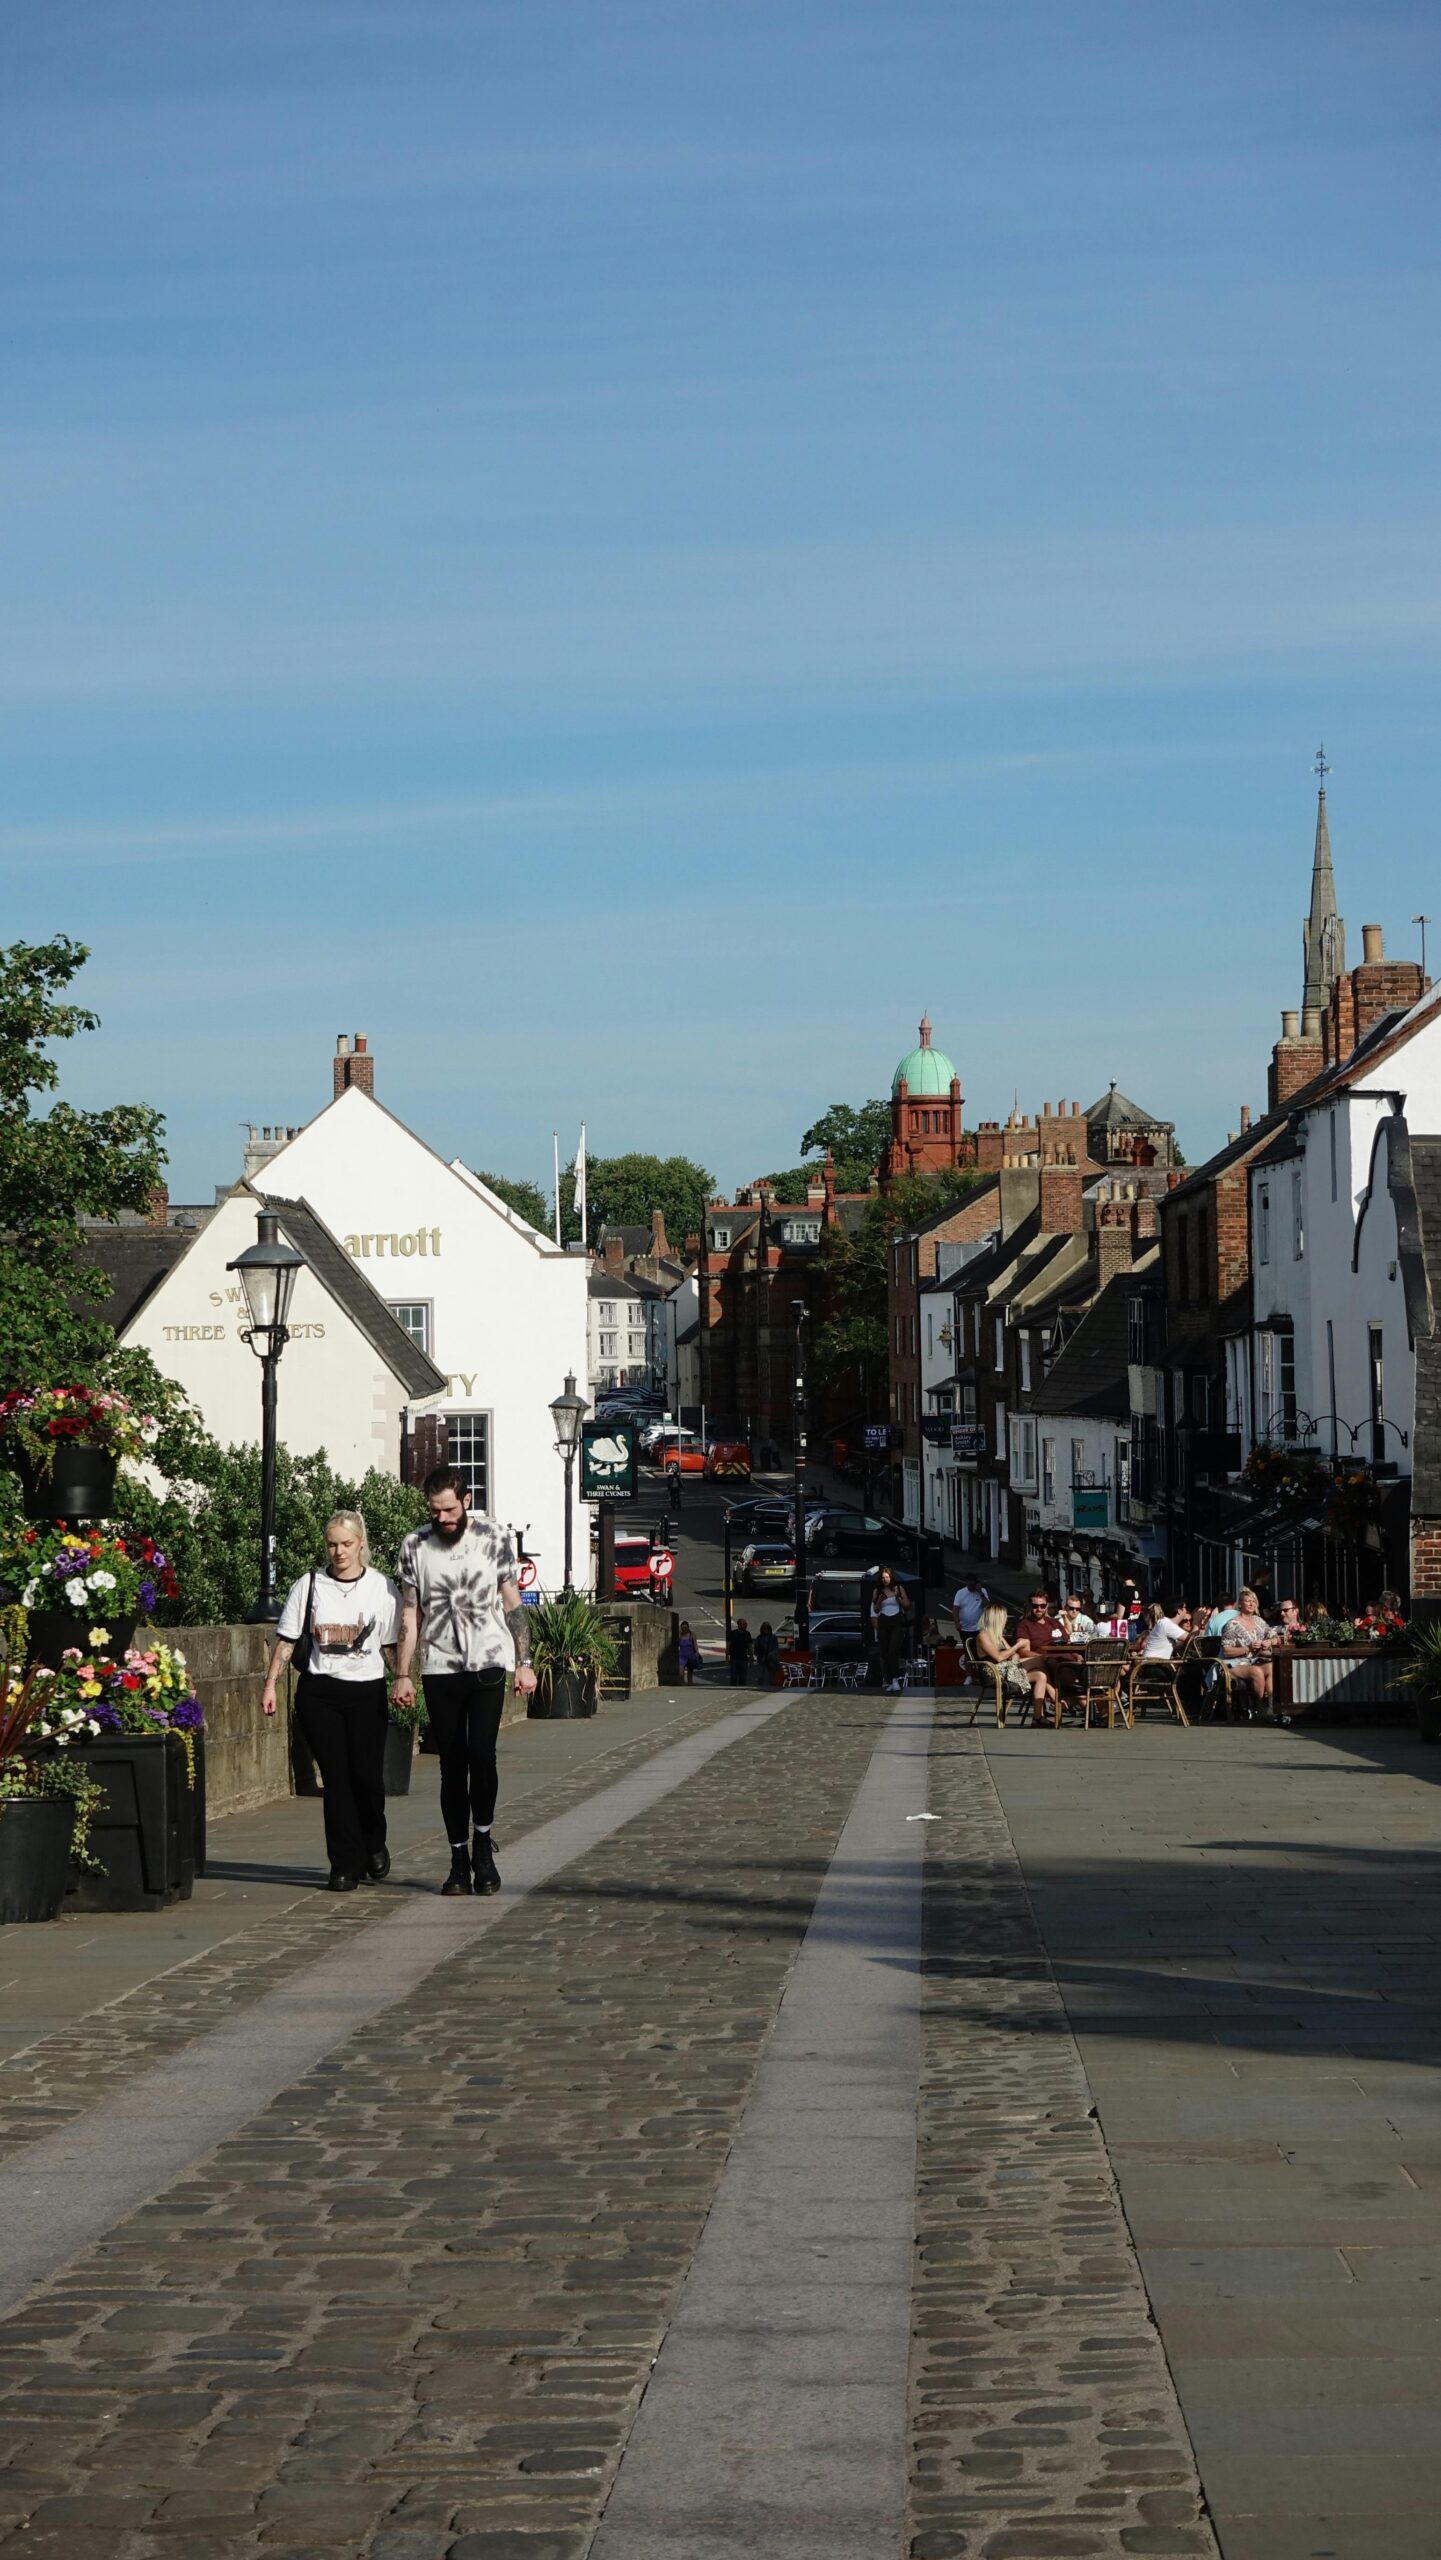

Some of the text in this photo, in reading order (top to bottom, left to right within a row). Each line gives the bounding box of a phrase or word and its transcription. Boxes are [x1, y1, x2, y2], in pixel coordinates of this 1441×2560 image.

[343, 1227, 442, 1257] arriott
[209, 1286, 243, 1307] SW
[162, 1323, 326, 1341] THREE CETS
[445, 1373, 479, 1397] TY
